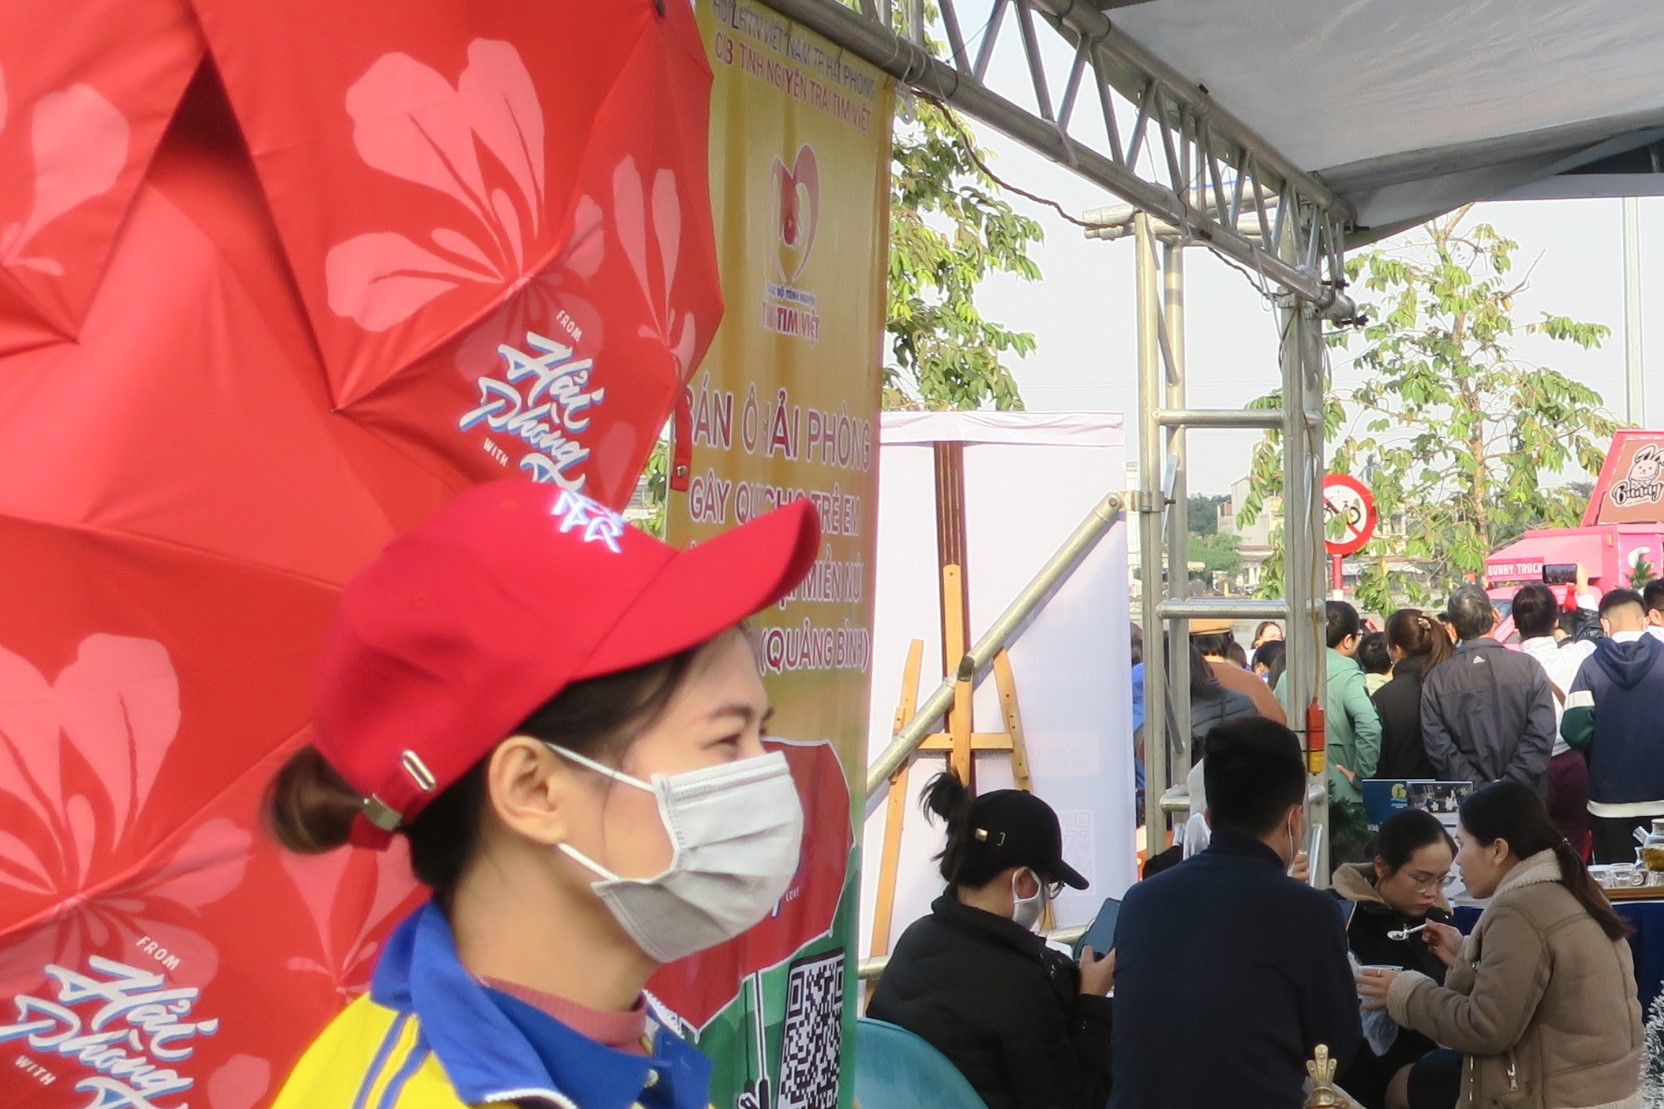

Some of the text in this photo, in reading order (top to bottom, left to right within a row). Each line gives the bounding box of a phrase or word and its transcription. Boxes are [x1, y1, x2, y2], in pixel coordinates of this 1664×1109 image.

[556, 310, 582, 342] FROM
[777, 306, 799, 334] TIM
[498, 331, 605, 431] Hải
[459, 377, 592, 492] Phòng
[807, 402, 871, 473] PHÒNG
[483, 438, 509, 466] WITH
[689, 468, 732, 523] GÂY
[1487, 563, 1514, 576] BUNNY
[136, 936, 181, 970] FROM
[44, 954, 219, 1062] Hải
[15, 1055, 56, 1086] WITH
